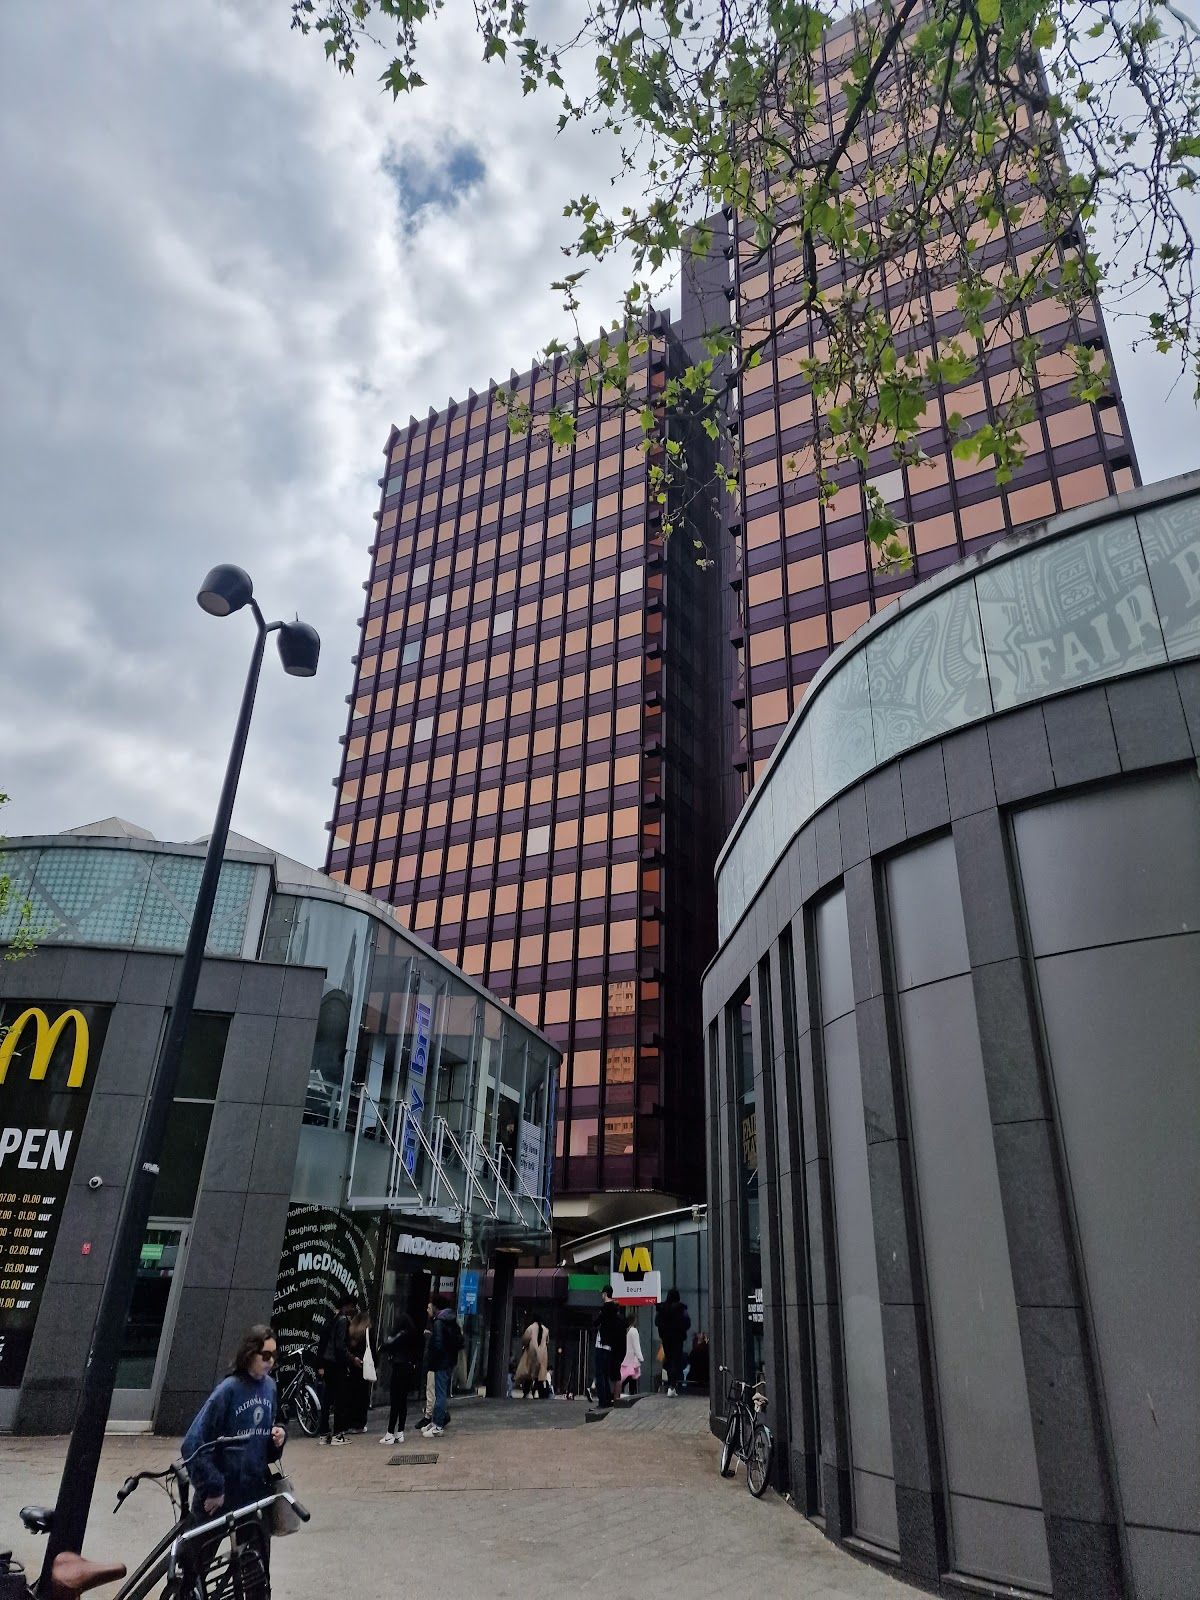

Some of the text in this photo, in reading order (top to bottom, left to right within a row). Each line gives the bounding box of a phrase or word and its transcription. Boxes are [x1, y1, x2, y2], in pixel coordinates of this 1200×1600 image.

[1020, 584, 1168, 688] FAIR
[410, 1002, 431, 1077] bril
[22, 1194, 41, 1204] 01.00
[42, 1196, 56, 1205] uur
[18, 1211, 36, 1221] 01.00
[38, 1213, 52, 1222] uur
[13, 1228, 32, 1238] 01.00
[34, 1230, 48, 1239] uur
[9, 1245, 29, 1255] 02.00
[29, 1247, 43, 1256] uur
[4, 1263, 39, 1274] 03.00 uur
[298, 1252, 359, 1299] McDonald's
[1, 1280, 35, 1291] 03.00 uur
[16, 1300, 30, 1309] uur
